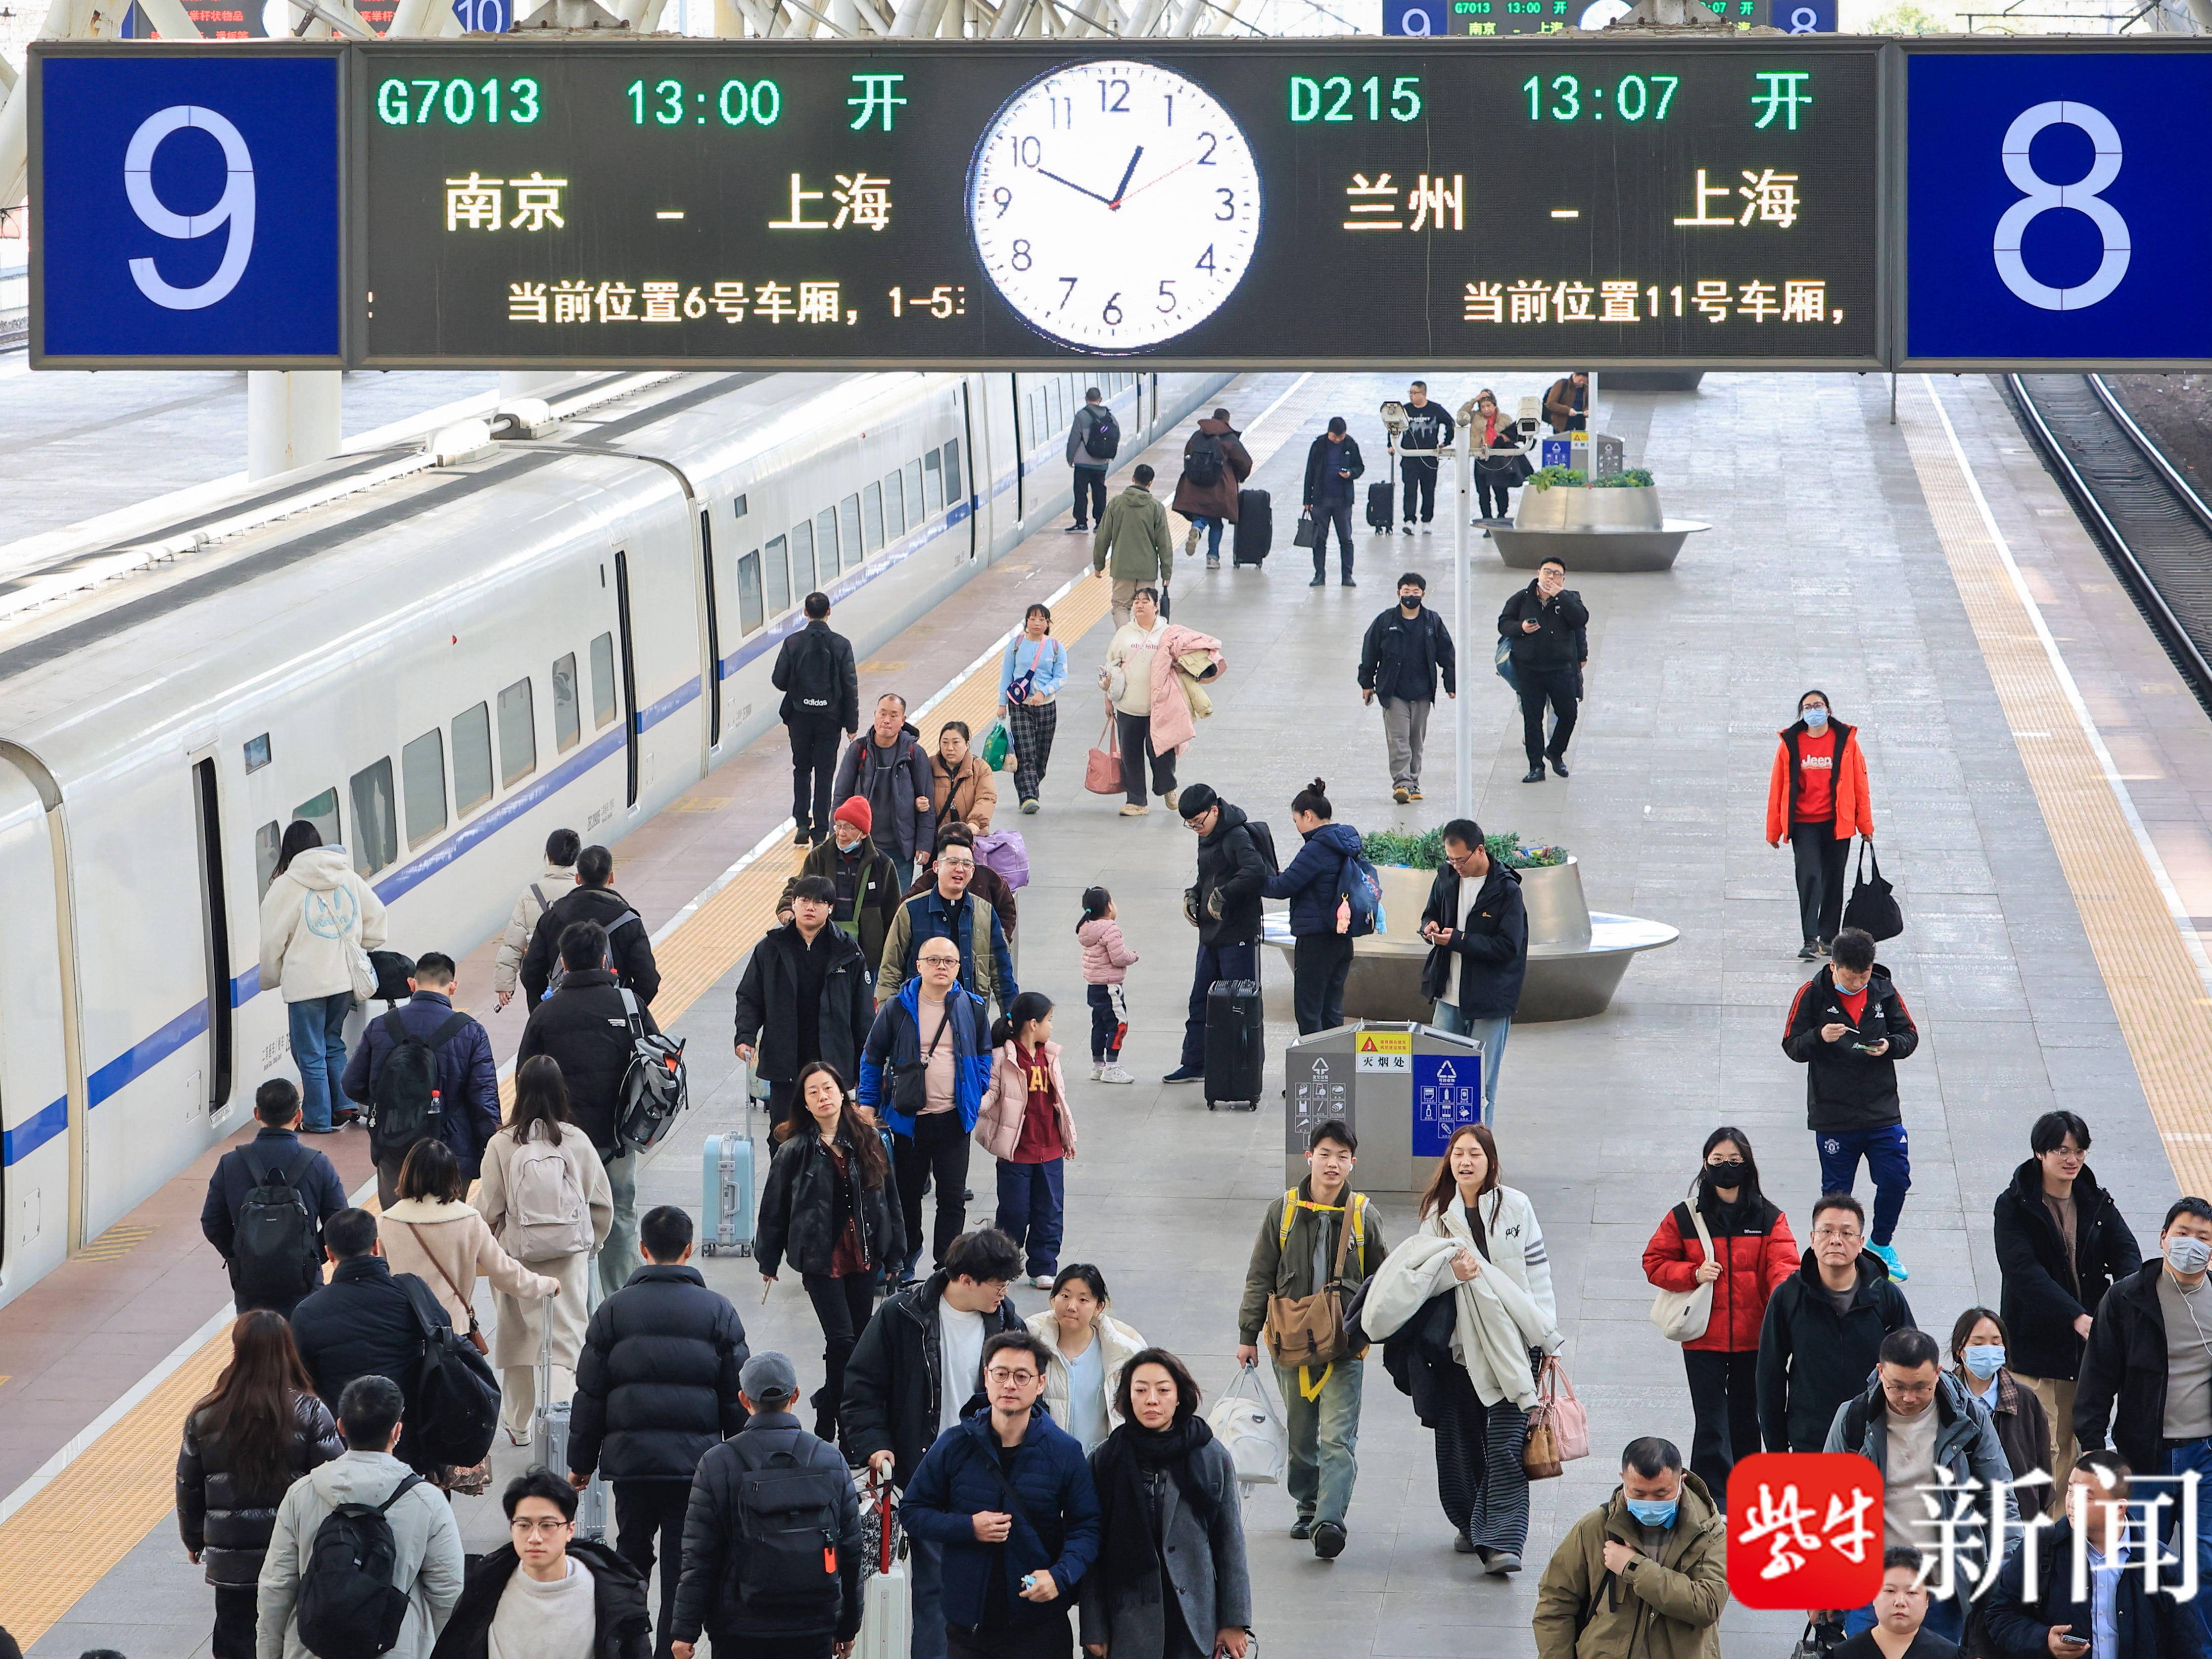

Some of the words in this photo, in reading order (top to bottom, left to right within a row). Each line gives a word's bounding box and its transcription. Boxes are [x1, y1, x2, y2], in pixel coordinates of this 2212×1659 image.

[188, 10, 244, 22] 举杆状物品
[360, 10, 394, 22] 高举杆
[458, 0, 502, 33] 10
[1402, 8, 1431, 36] 9
[1454, 1, 1491, 14] G7013
[1507, 1, 1542, 14] 13:00
[1553, 0, 1568, 15] 开
[1739, 0, 1754, 15] 开
[1790, 7, 1818, 34] 8
[1468, 21, 1497, 36] 南京
[377, 79, 539, 125] G7013
[627, 80, 780, 125] 13:00
[847, 75, 907, 131] 开
[1097, 80, 1130, 112] 12
[1164, 95, 1173, 126] 1
[1290, 76, 1421, 122] D215
[1523, 75, 1679, 121] 13:07
[1751, 72, 1813, 130] 开
[1050, 97, 1071, 129] 11
[1012, 136, 1041, 168] 10
[1197, 132, 1217, 165] 2
[125, 105, 256, 310] 9
[445, 172, 568, 232] 南京
[768, 173, 892, 231] 上海
[993, 187, 1012, 218] 9
[1215, 188, 1234, 221] 3
[1343, 173, 1463, 232] 兰州
[1673, 169, 1800, 228] 上海
[1993, 101, 2131, 311] 8
[1011, 239, 1032, 271] 8
[1195, 243, 1216, 276] 4
[1059, 277, 1078, 309] 7
[1103, 292, 1123, 325] 6
[1157, 281, 1176, 313] 5
[803, 698, 828, 707] adidas
[1801, 754, 1832, 767] Jeep
[1363, 1056, 1405, 1068] 灭烟处
